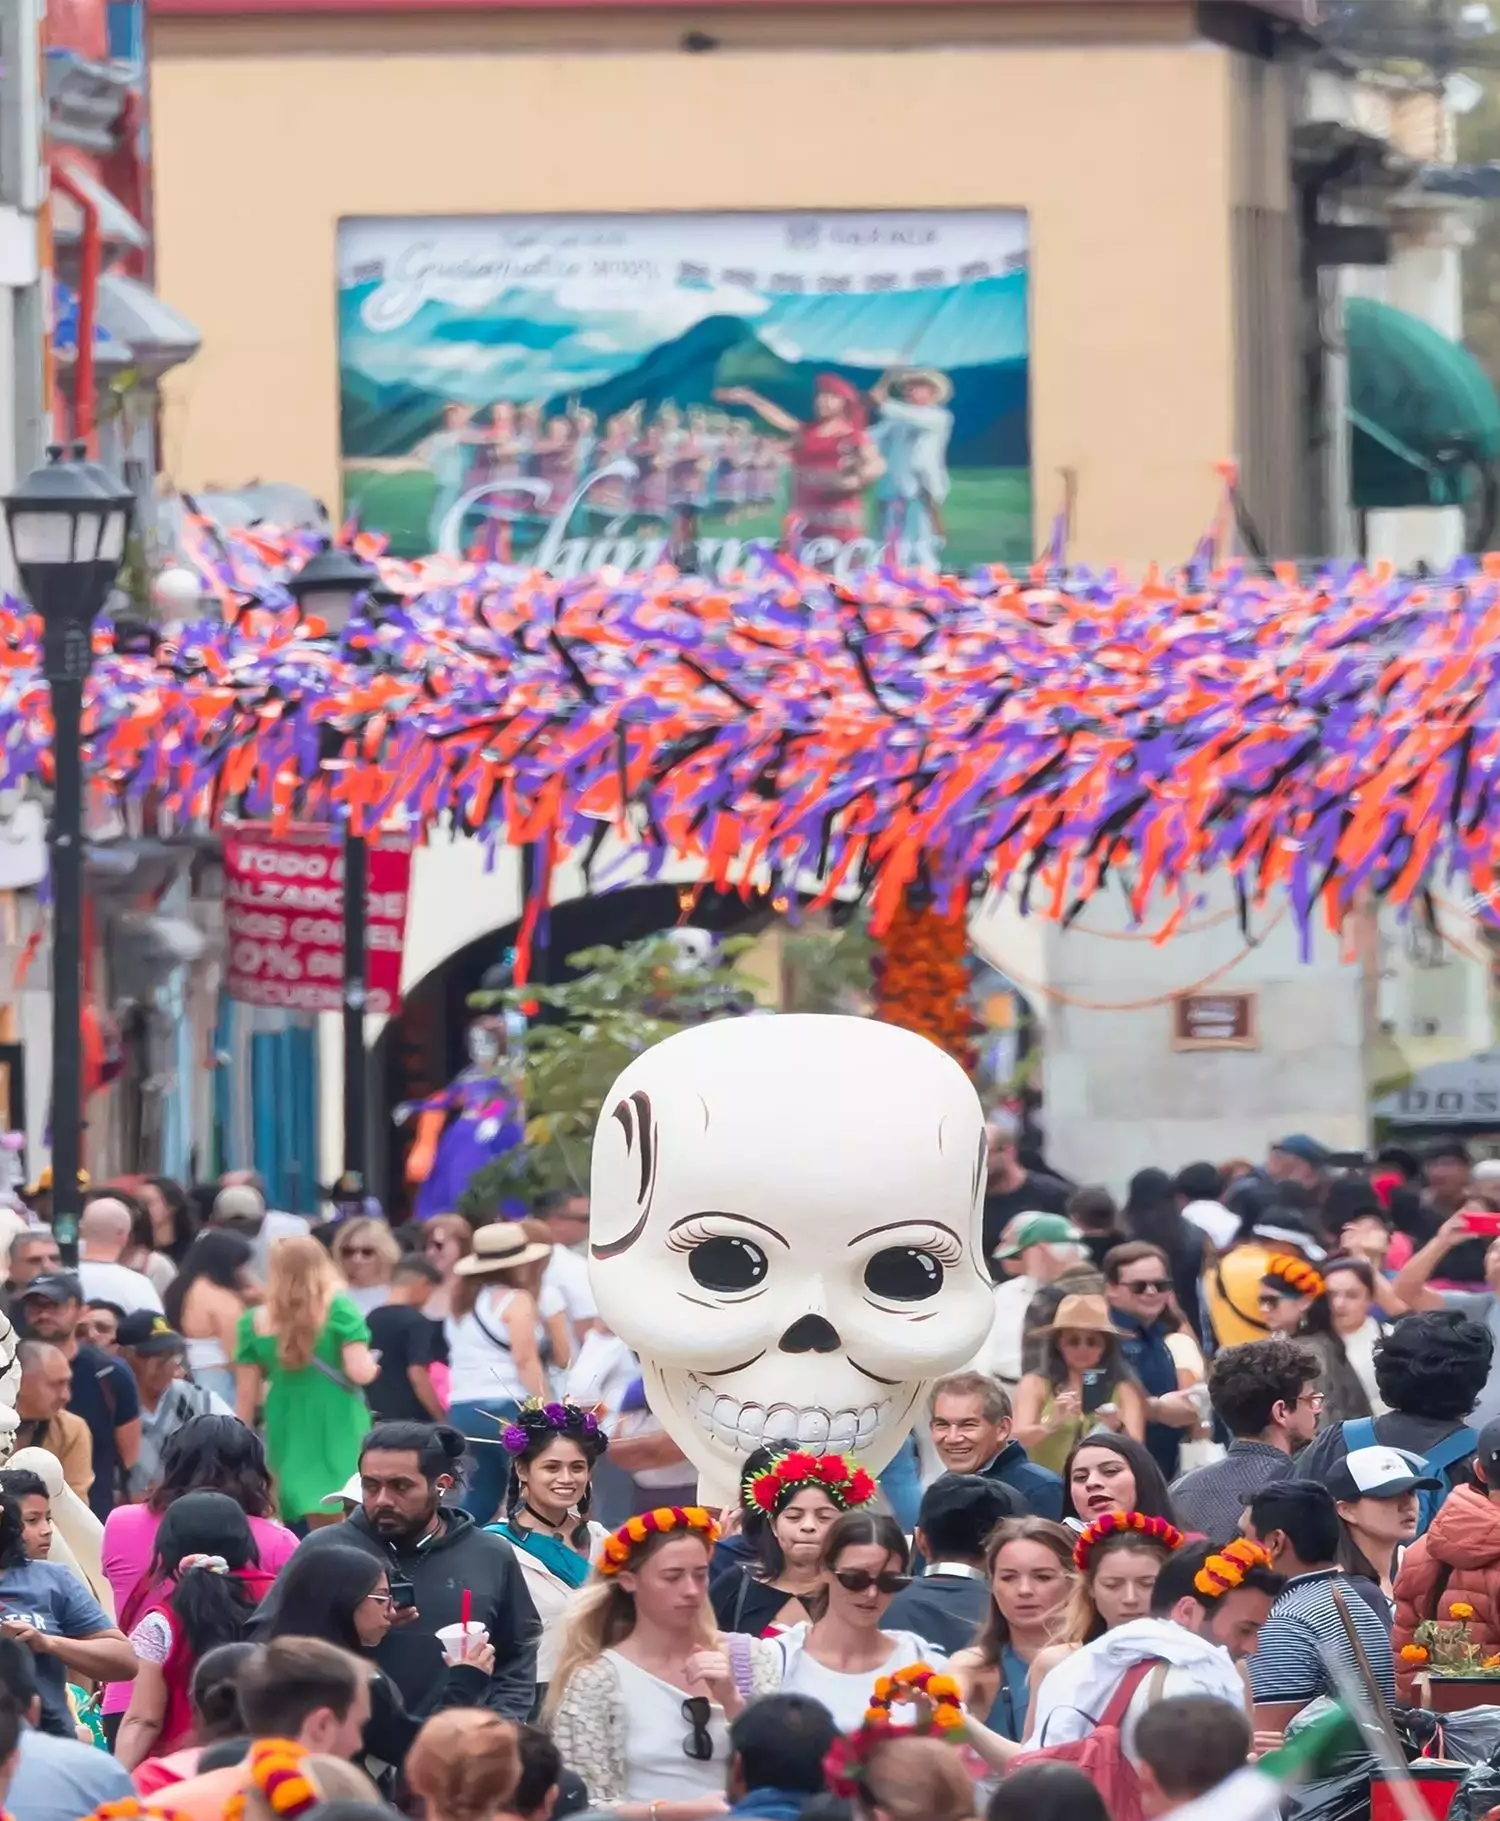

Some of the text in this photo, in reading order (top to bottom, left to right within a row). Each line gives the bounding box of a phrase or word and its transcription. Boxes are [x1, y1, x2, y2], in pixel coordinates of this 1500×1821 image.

[238, 845, 328, 880] TODO
[226, 877, 347, 915] ALZADO
[232, 938, 302, 980] 0%
[1400, 1088, 1499, 1114] DOS
